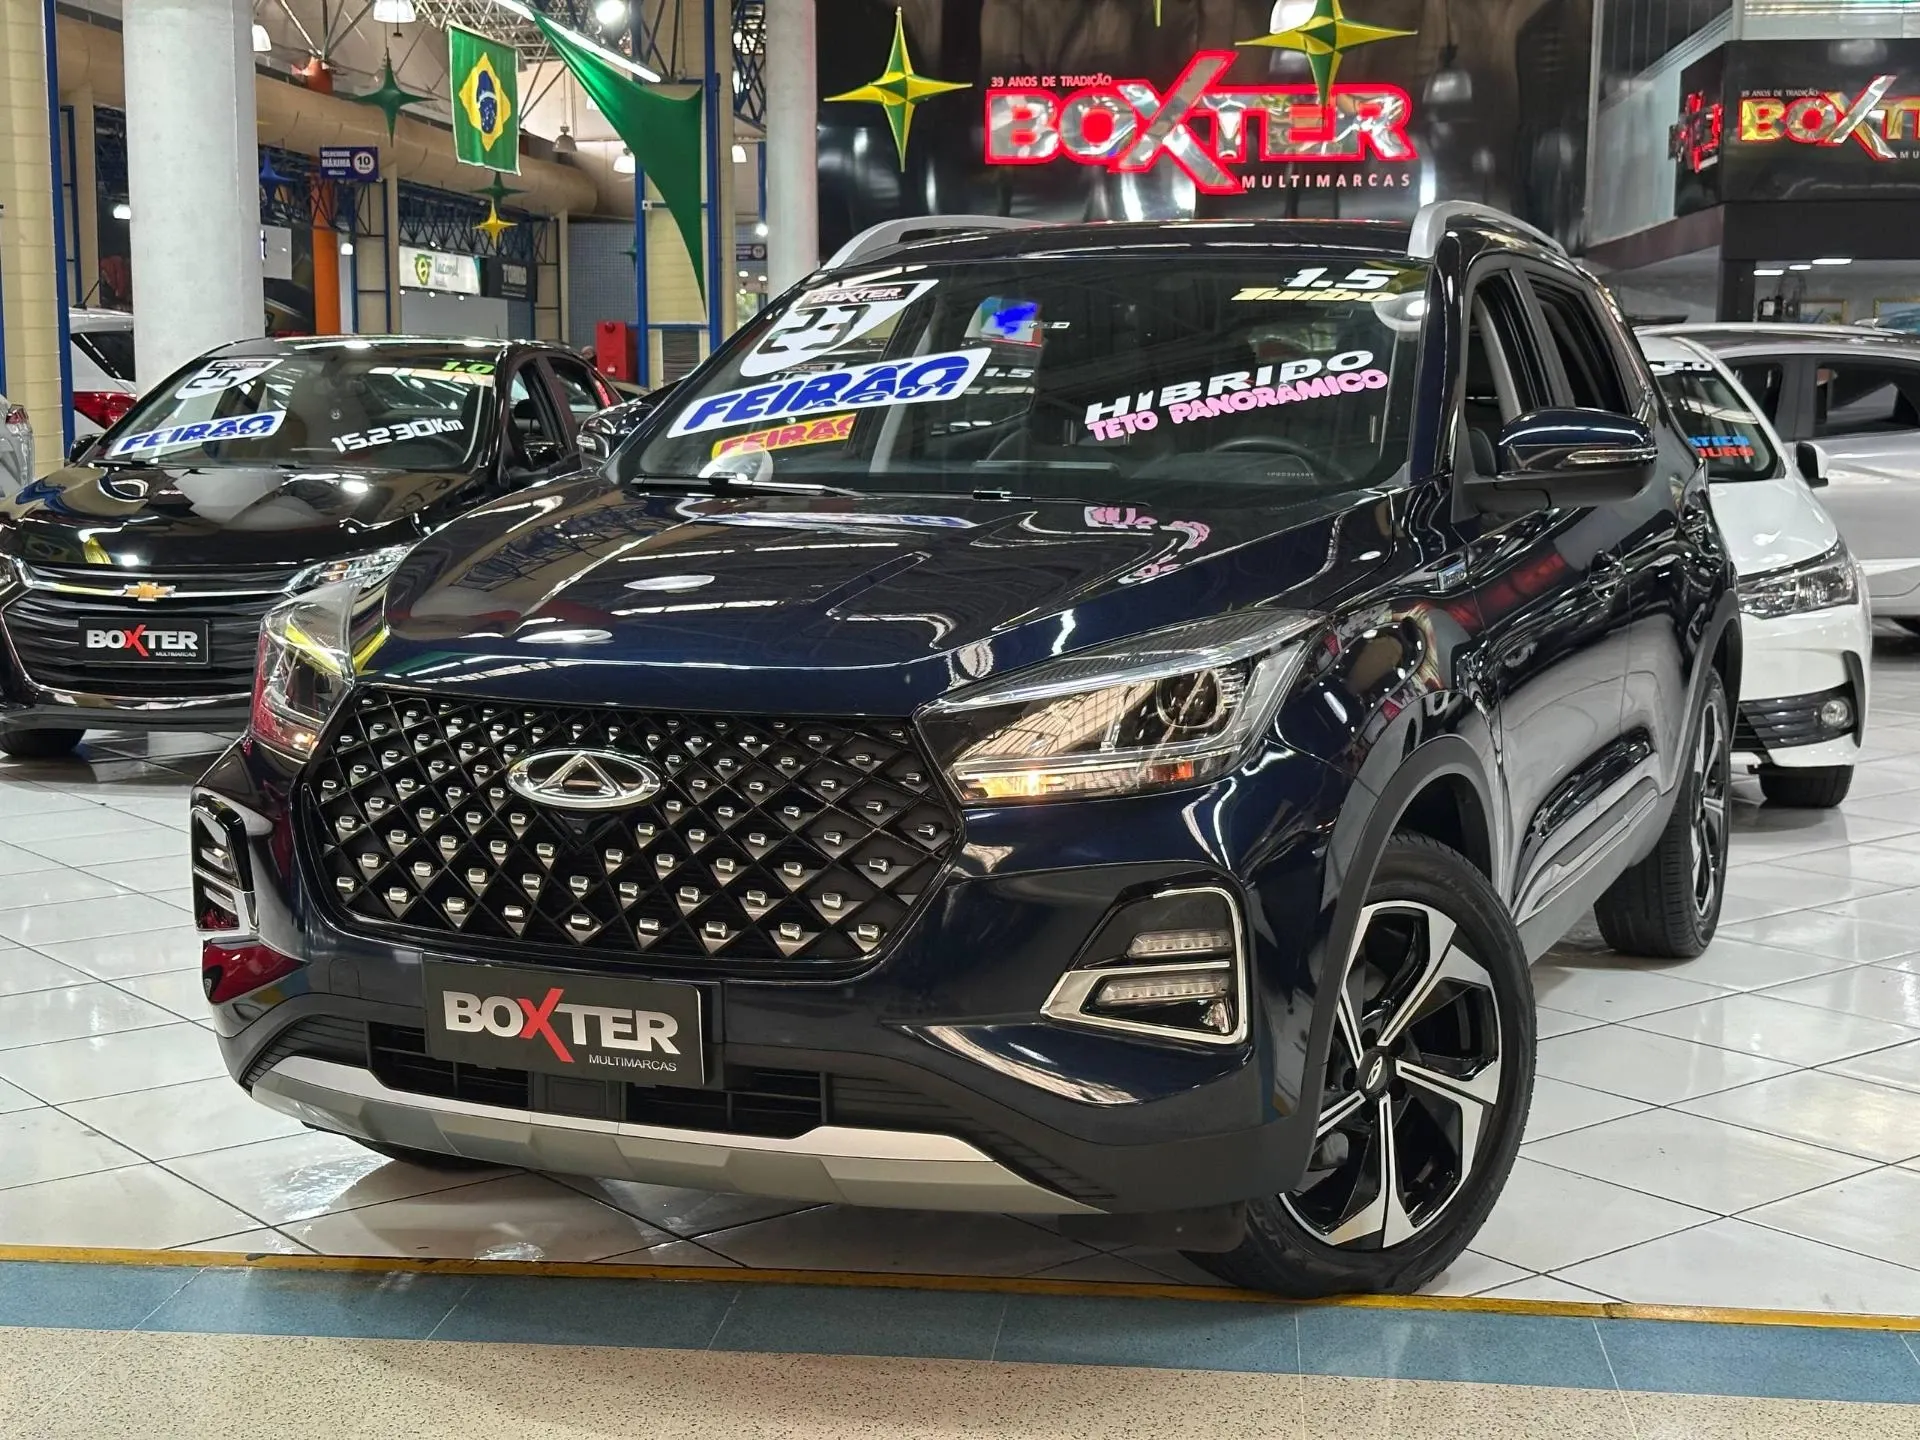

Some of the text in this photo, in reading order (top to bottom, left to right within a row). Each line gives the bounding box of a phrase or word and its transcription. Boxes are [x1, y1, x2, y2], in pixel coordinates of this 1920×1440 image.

[990, 72, 1113, 88] 39 ANOS DE TRADIÇÃO
[985, 49, 1417, 195] BOXTER
[1738, 74, 1920, 160] BOXT
[356, 155, 371, 166] 10
[1241, 173, 1411, 189] MULTIMARCAS
[1230, 287, 1400, 303] Turbo
[1286, 267, 1400, 290] 1.5
[440, 361, 496, 374] 1.0
[683, 355, 969, 431] FEIRÃO
[1086, 368, 1389, 442] TETO PANORÂMICO
[120, 414, 275, 452] FEIRÃO
[331, 417, 465, 454] 15.230Km
[86, 624, 199, 657] BOXTER
[442, 987, 681, 1063] BOXTER
[588, 1053, 678, 1073] MULTIMARCAS
